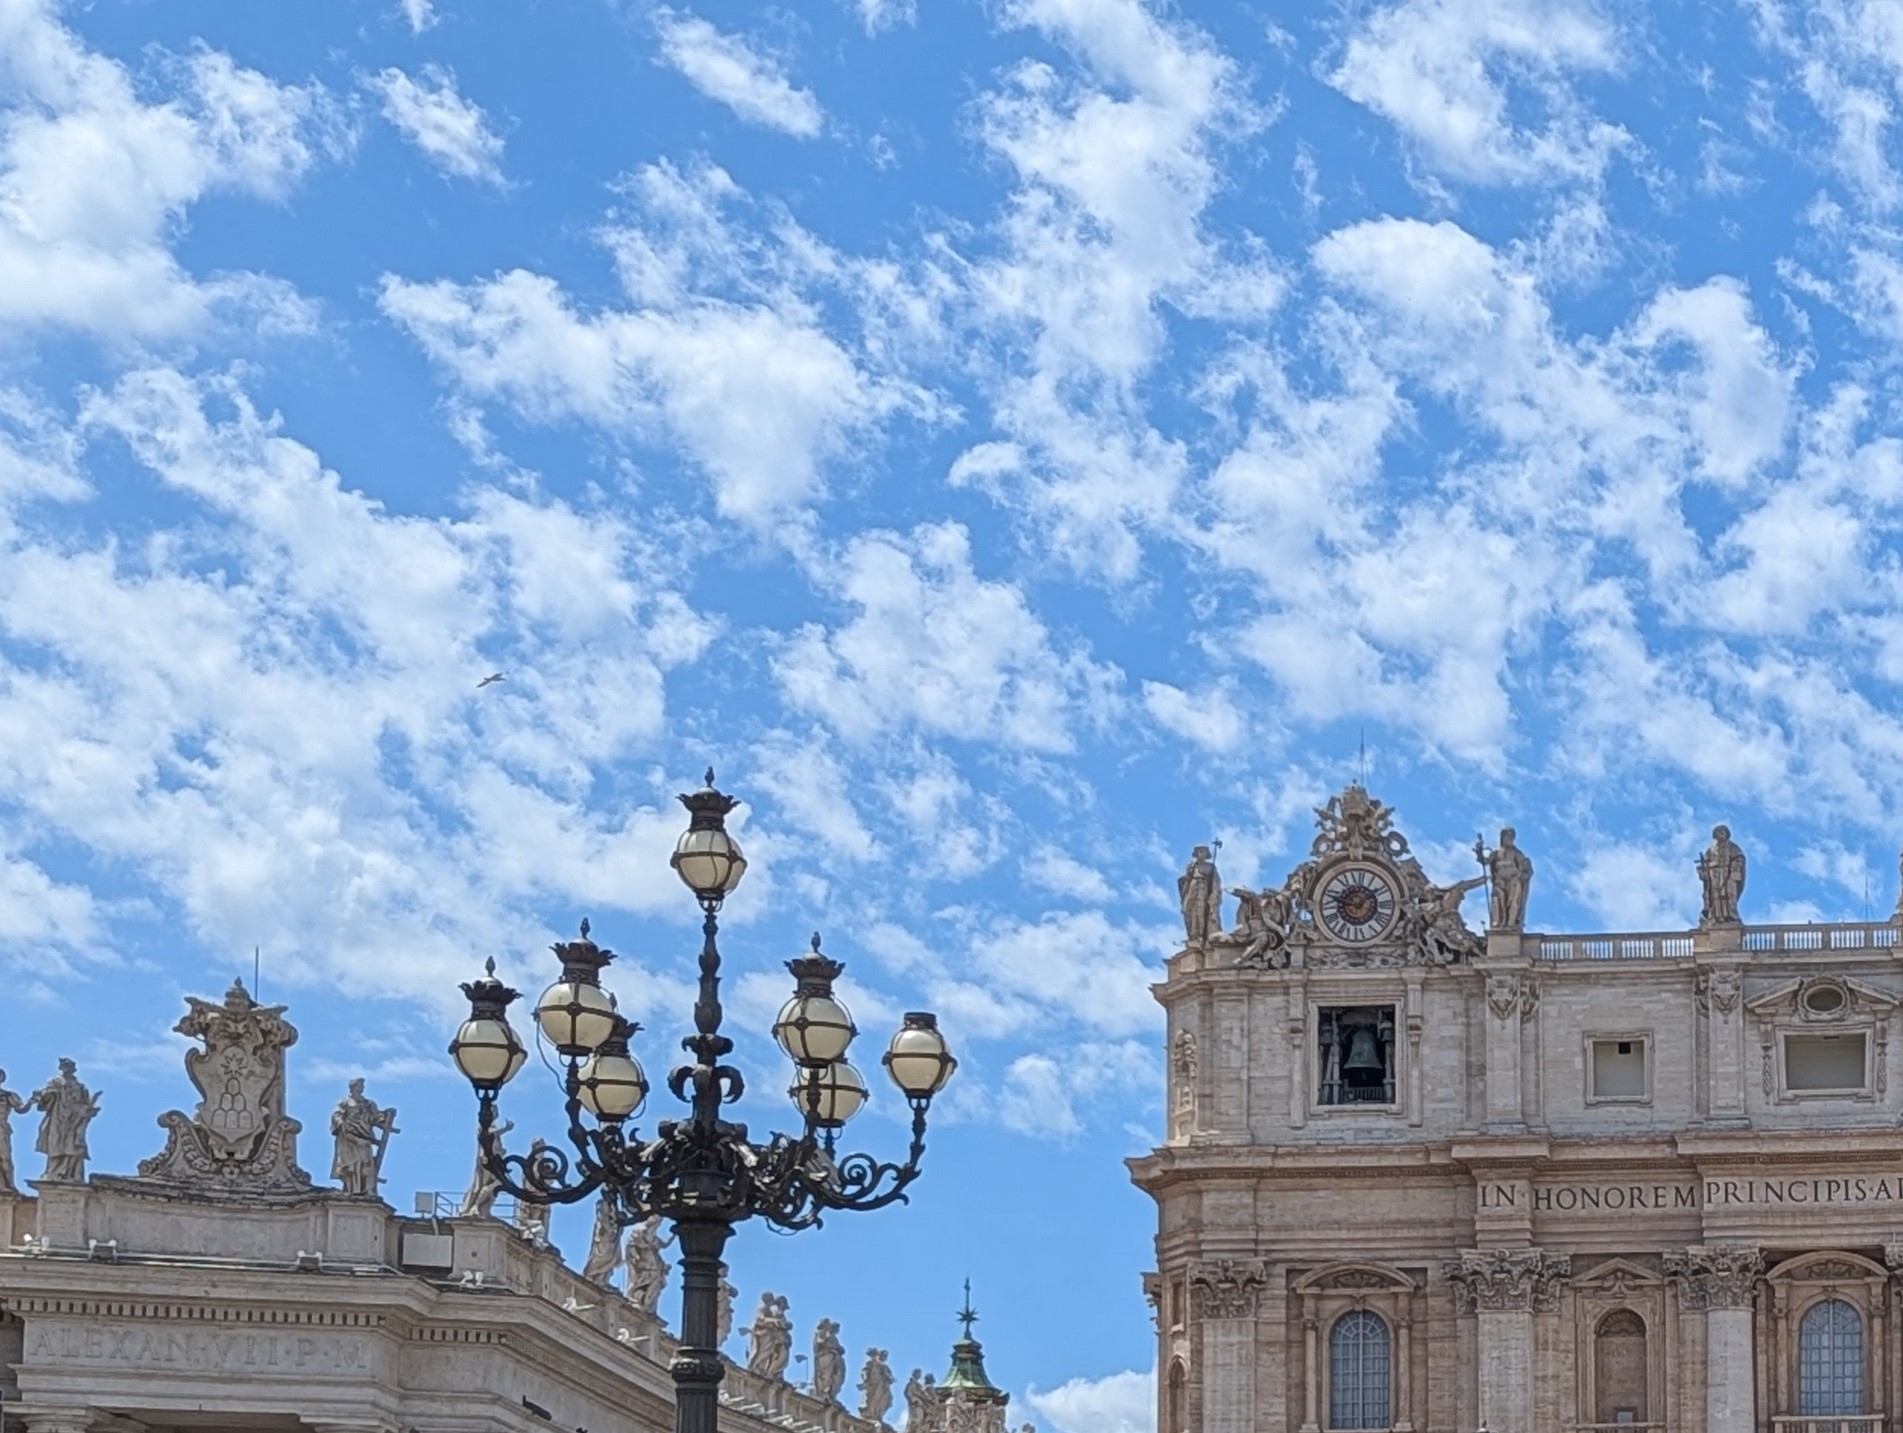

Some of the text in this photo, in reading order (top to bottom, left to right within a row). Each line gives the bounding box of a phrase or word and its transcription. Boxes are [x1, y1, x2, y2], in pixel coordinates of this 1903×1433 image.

[1479, 1184, 1517, 1207] IN
[1534, 1185, 1697, 1210] HONOREM
[1705, 1179, 1867, 1204] PRINCIPIS
